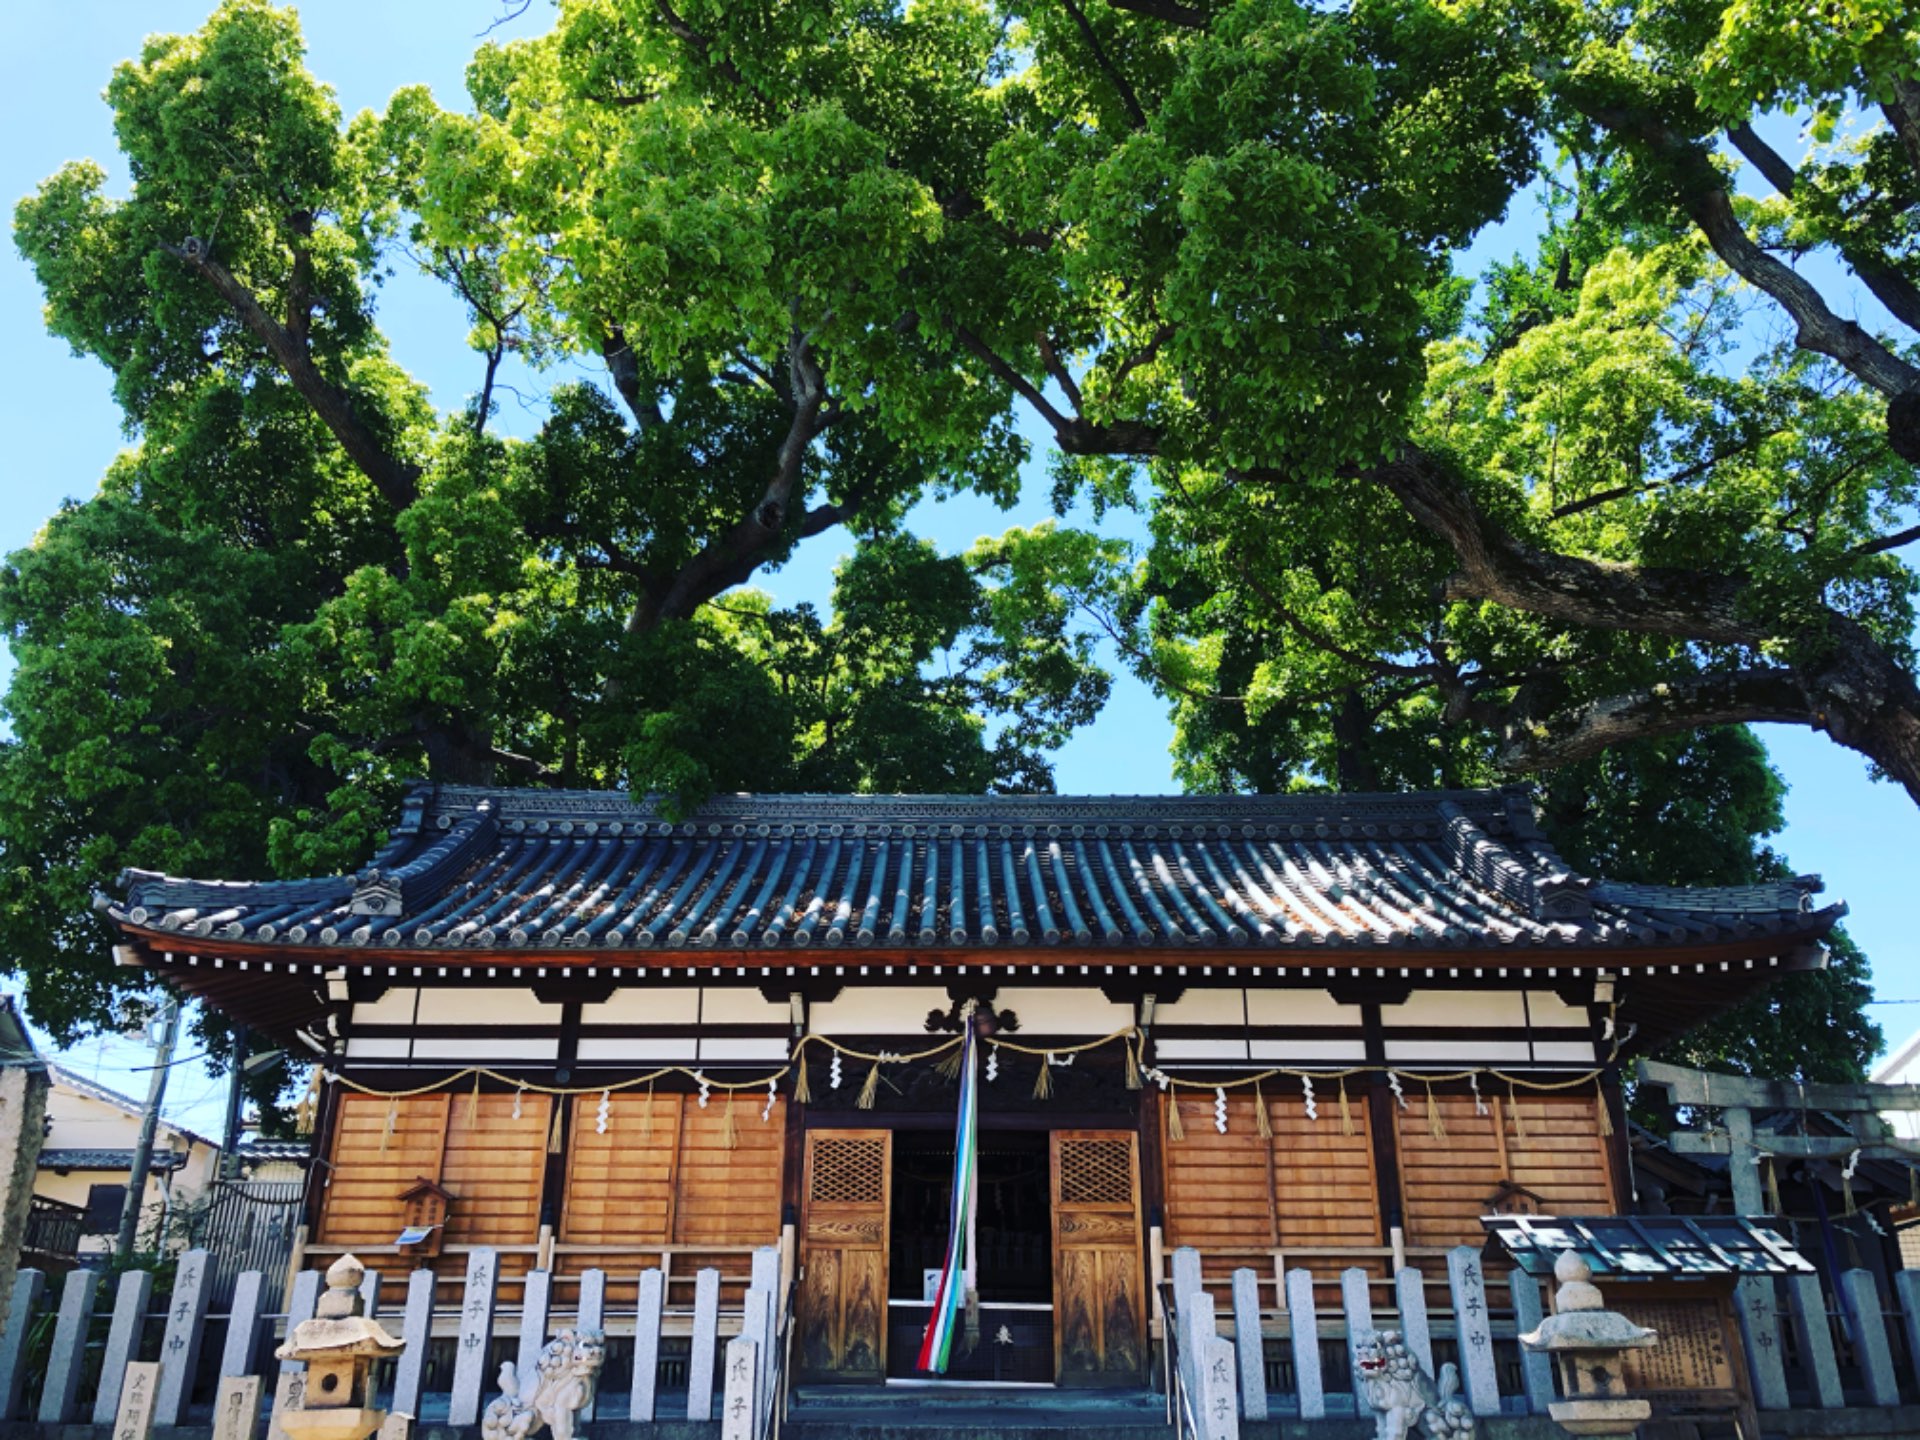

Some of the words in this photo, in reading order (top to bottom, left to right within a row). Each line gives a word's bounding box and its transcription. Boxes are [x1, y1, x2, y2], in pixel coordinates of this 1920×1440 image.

[464, 1265, 486, 1353] 氏子中
[1464, 1263, 1486, 1351] 氏子中
[730, 1357, 747, 1440] 氏子
[1213, 1358, 1231, 1440] 氏子
